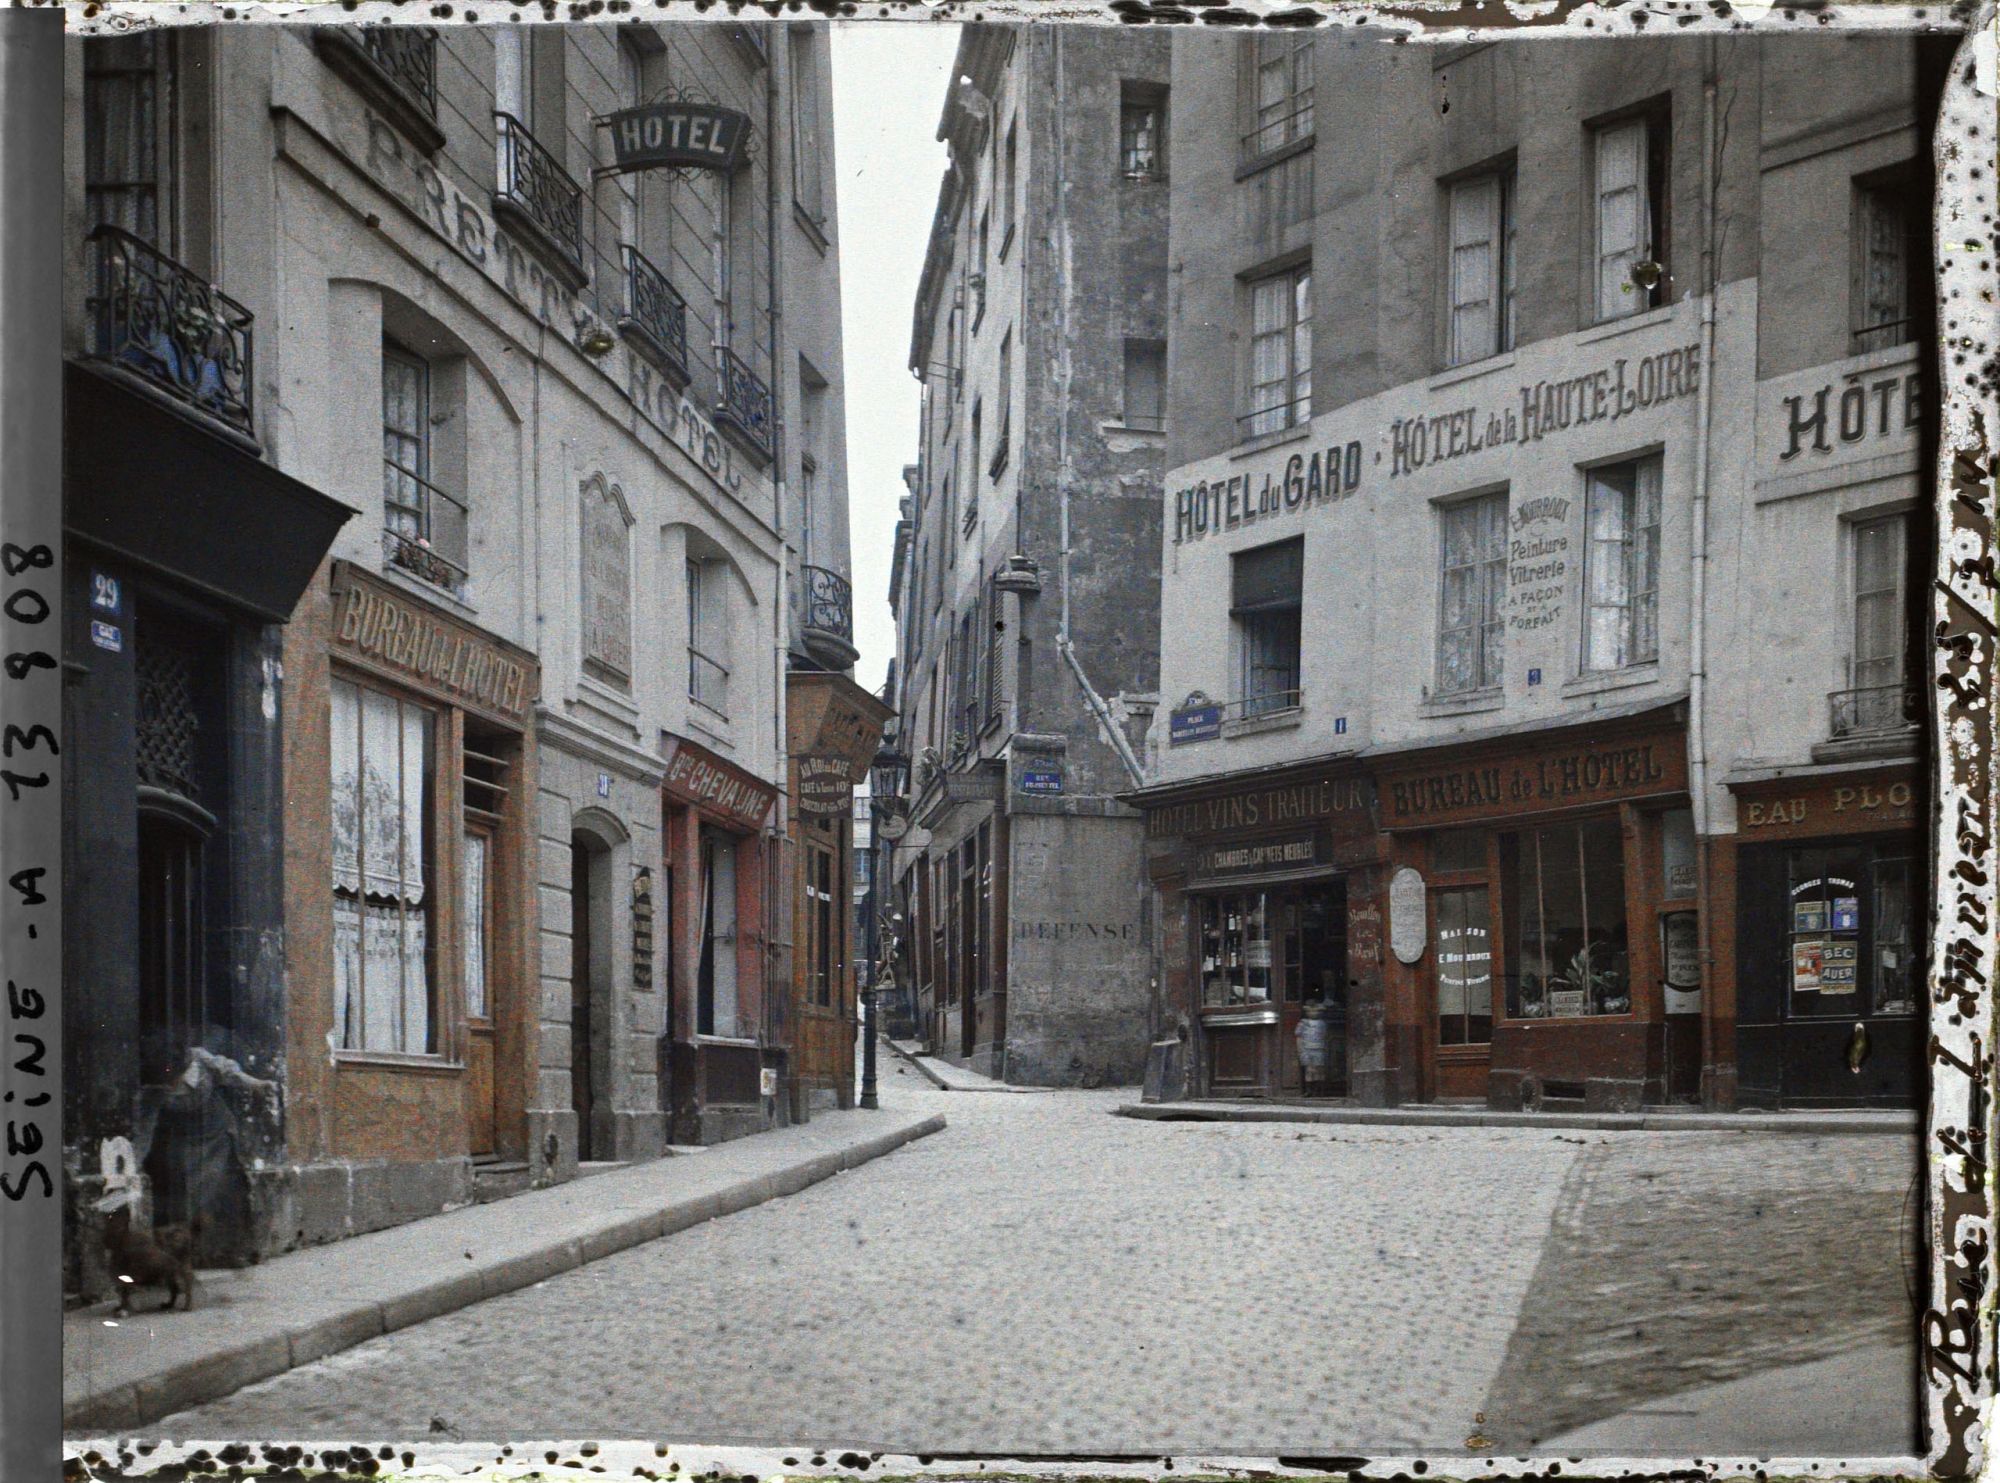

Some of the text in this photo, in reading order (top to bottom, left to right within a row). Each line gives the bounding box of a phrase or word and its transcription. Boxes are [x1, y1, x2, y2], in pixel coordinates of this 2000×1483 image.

[620, 114, 726, 154] HOTEL
[627, 350, 742, 491] HOTEL
[1389, 406, 1483, 479] HÔTEL
[1485, 411, 1502, 448] de
[1504, 407, 1518, 443] la
[1174, 440, 1363, 543] HÔTEL du GARD
[1511, 536, 1568, 563] Peinture
[1509, 560, 1566, 586] Vitrerie
[95, 573, 118, 609] 29
[1508, 584, 1564, 607] A FAÇON
[340, 586, 440, 674] BUREAU
[1509, 606, 1561, 631] FORFAIT
[810, 757, 825, 775] ROI
[688, 760, 768, 820] CHEVALINE
[1392, 767, 1500, 817] BUREAU
[1511, 767, 1532, 799] de
[1150, 778, 1363, 834] HOTEL VINS TRAITEUR
[1747, 799, 1807, 827] EAU
[1214, 848, 1248, 868] CHAMBRES
[1791, 877, 1855, 896] GEORGES THOMAS
[1020, 922, 1134, 940] DEFENSE
[1440, 927, 1487, 941] MAISON
[1824, 947, 1852, 960] BEC
[1822, 967, 1853, 980] AUER
